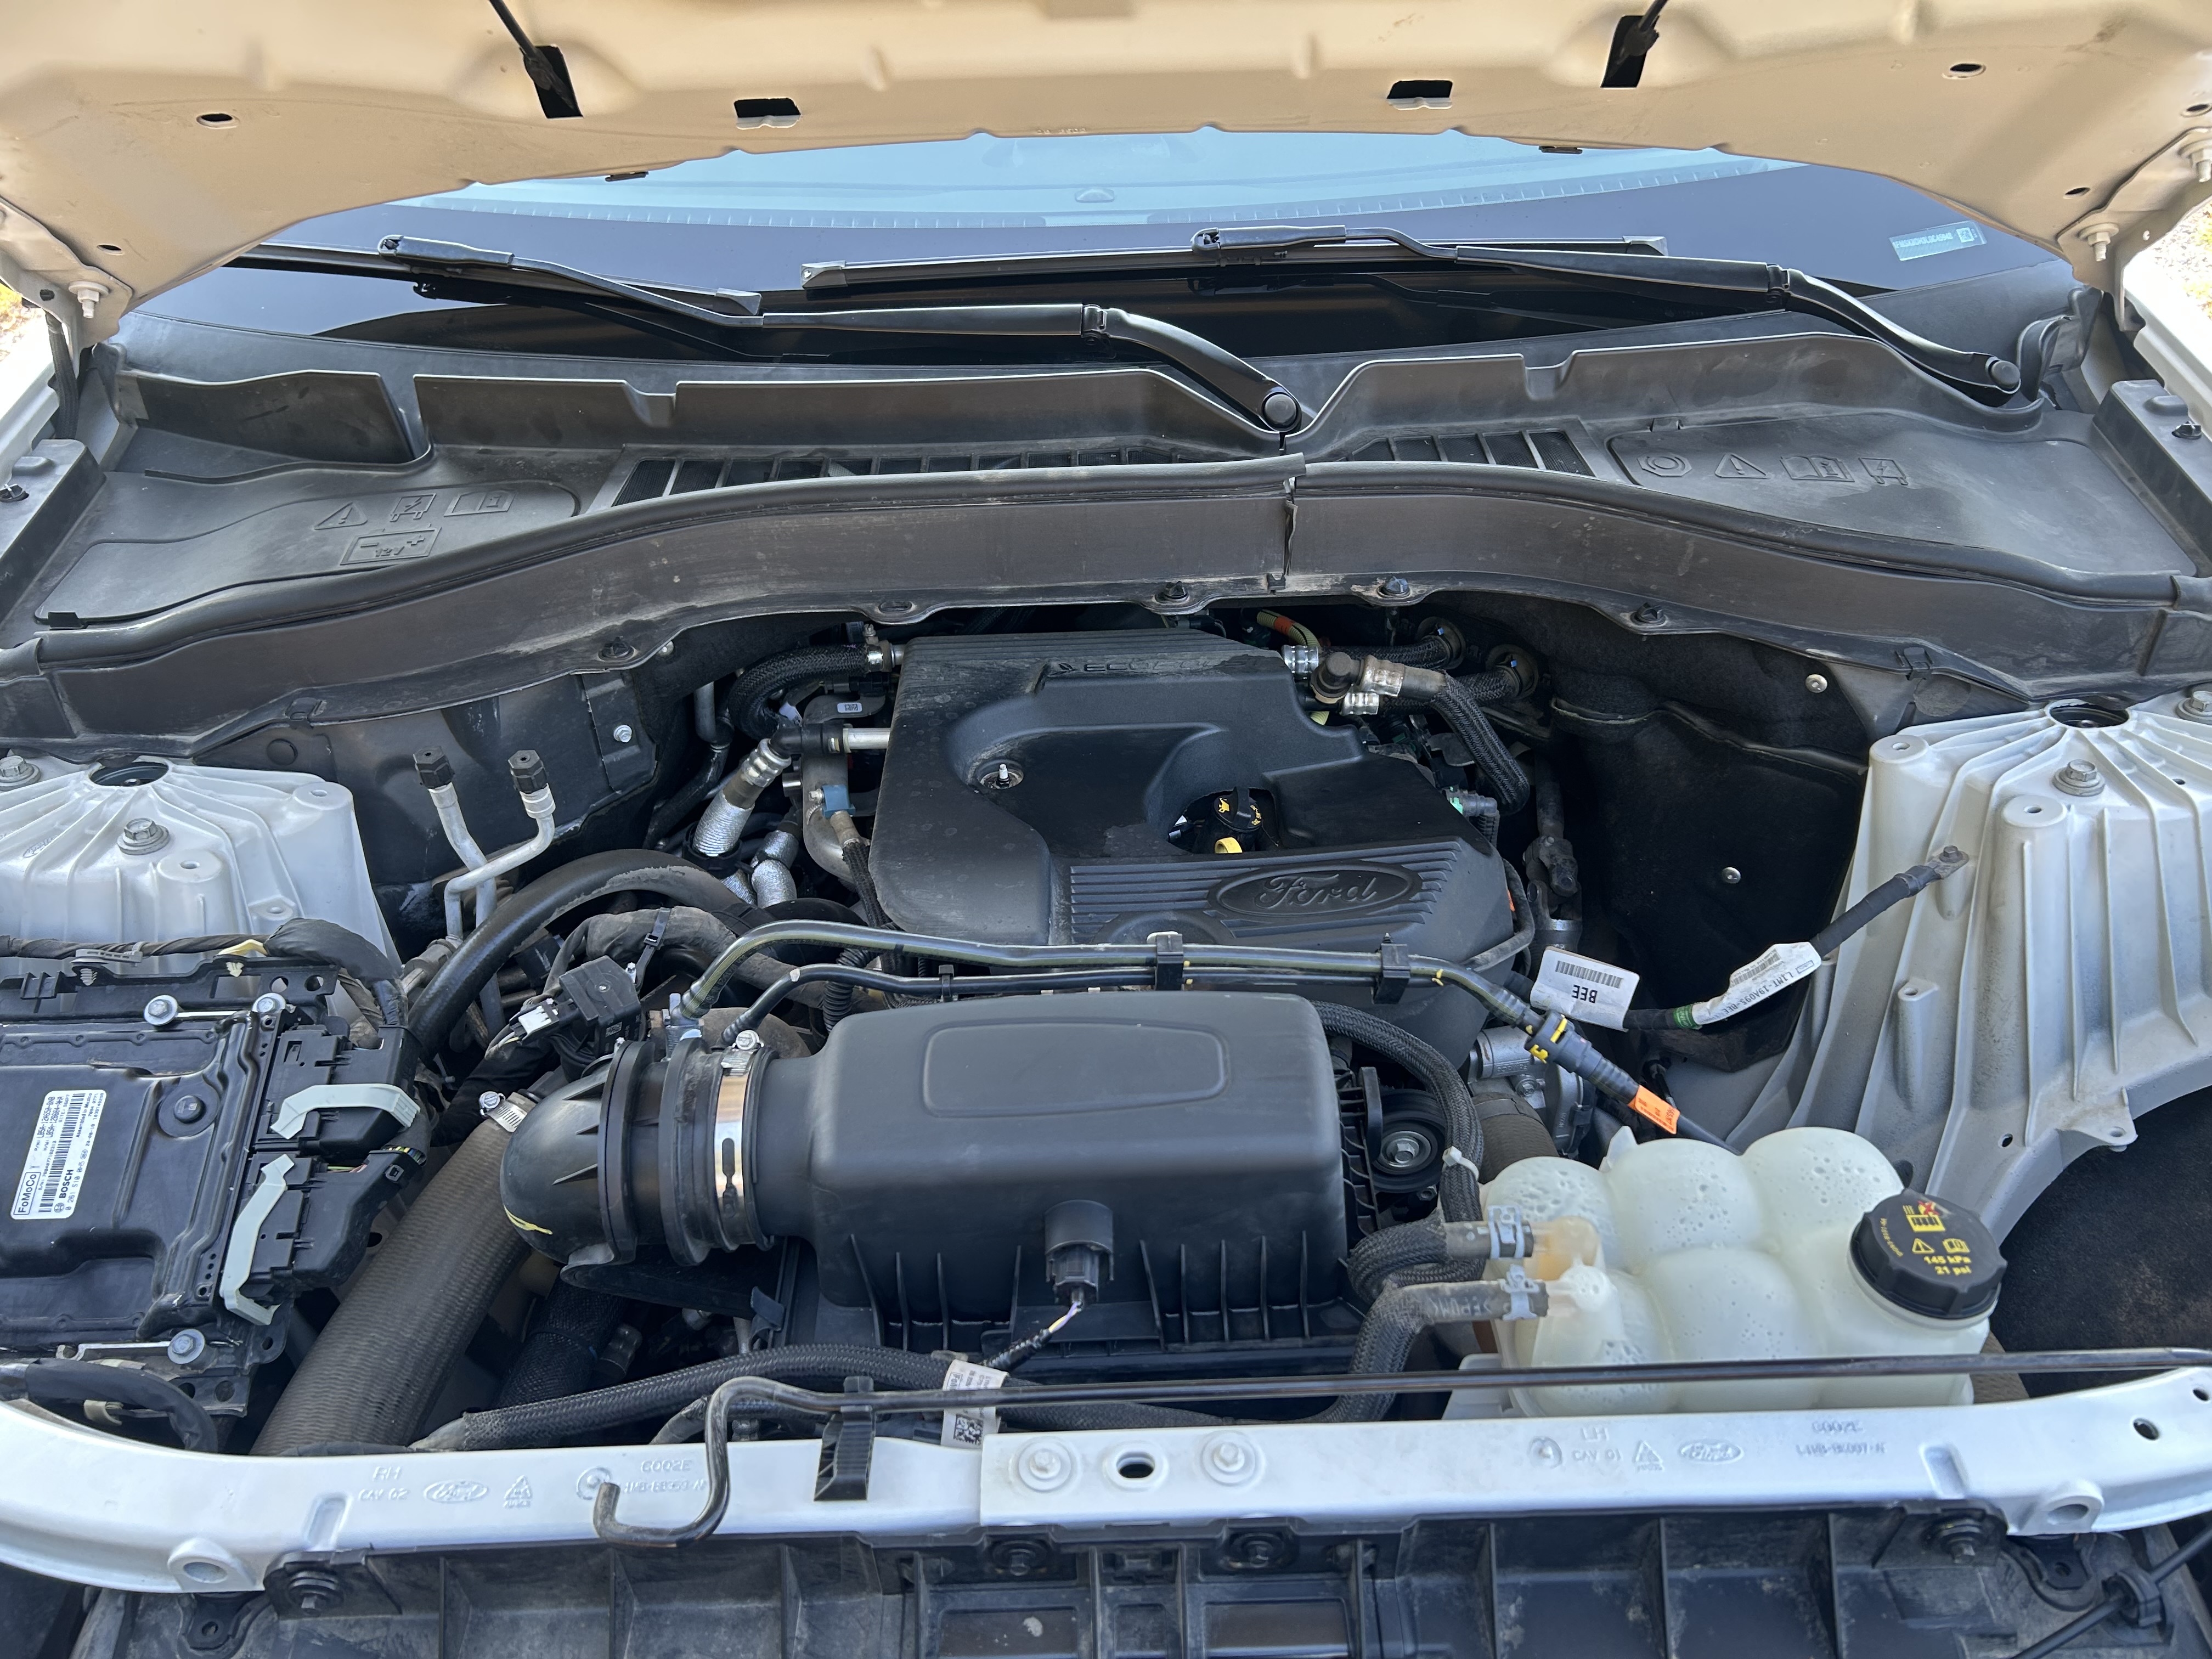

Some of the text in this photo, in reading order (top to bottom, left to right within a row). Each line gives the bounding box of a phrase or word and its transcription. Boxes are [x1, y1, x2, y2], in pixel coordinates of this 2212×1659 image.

[1259, 873, 1378, 907] Ford
[1571, 985, 1598, 1004] BEE
[18, 1174, 37, 1212] FoMoCo
[59, 1170, 73, 1199] BOSCH
[1923, 1256, 1946, 1264] 145
